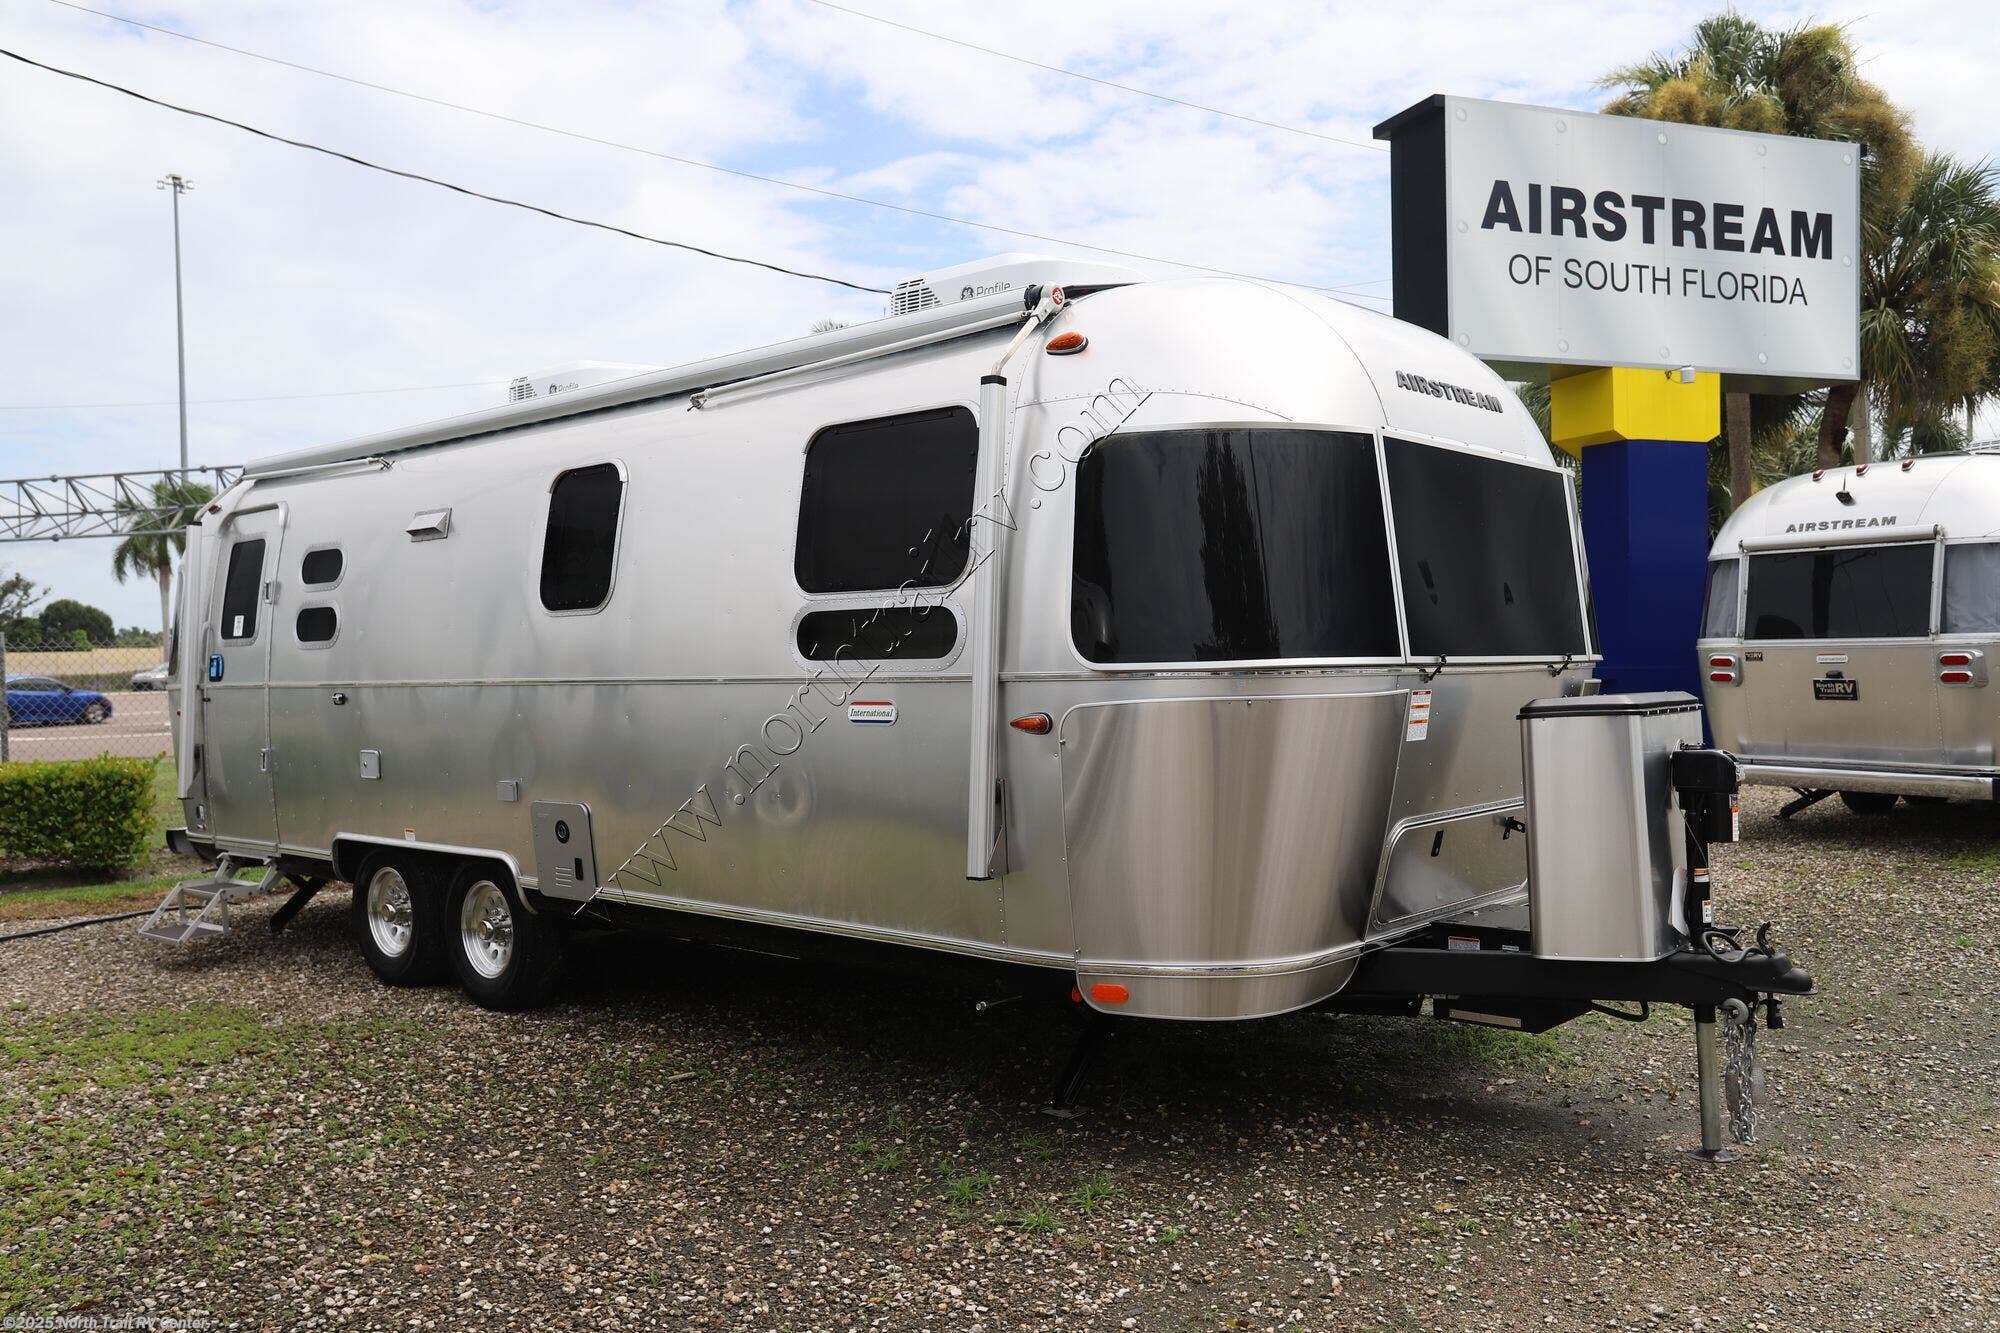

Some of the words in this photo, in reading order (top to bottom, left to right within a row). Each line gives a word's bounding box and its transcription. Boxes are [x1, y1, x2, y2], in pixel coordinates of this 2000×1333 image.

[1481, 180, 1833, 260] AIRSTREAM
[1508, 253, 1553, 285] OF
[1564, 259, 1671, 295] SOUTH
[1682, 268, 1809, 306] FLORIDA
[976, 282, 1011, 296] Profile
[1396, 370, 1503, 413] AIRSTREAM
[1785, 516, 1897, 533] AIRSTREAM
[1834, 682, 1854, 693] RV
[850, 708, 893, 717] International
